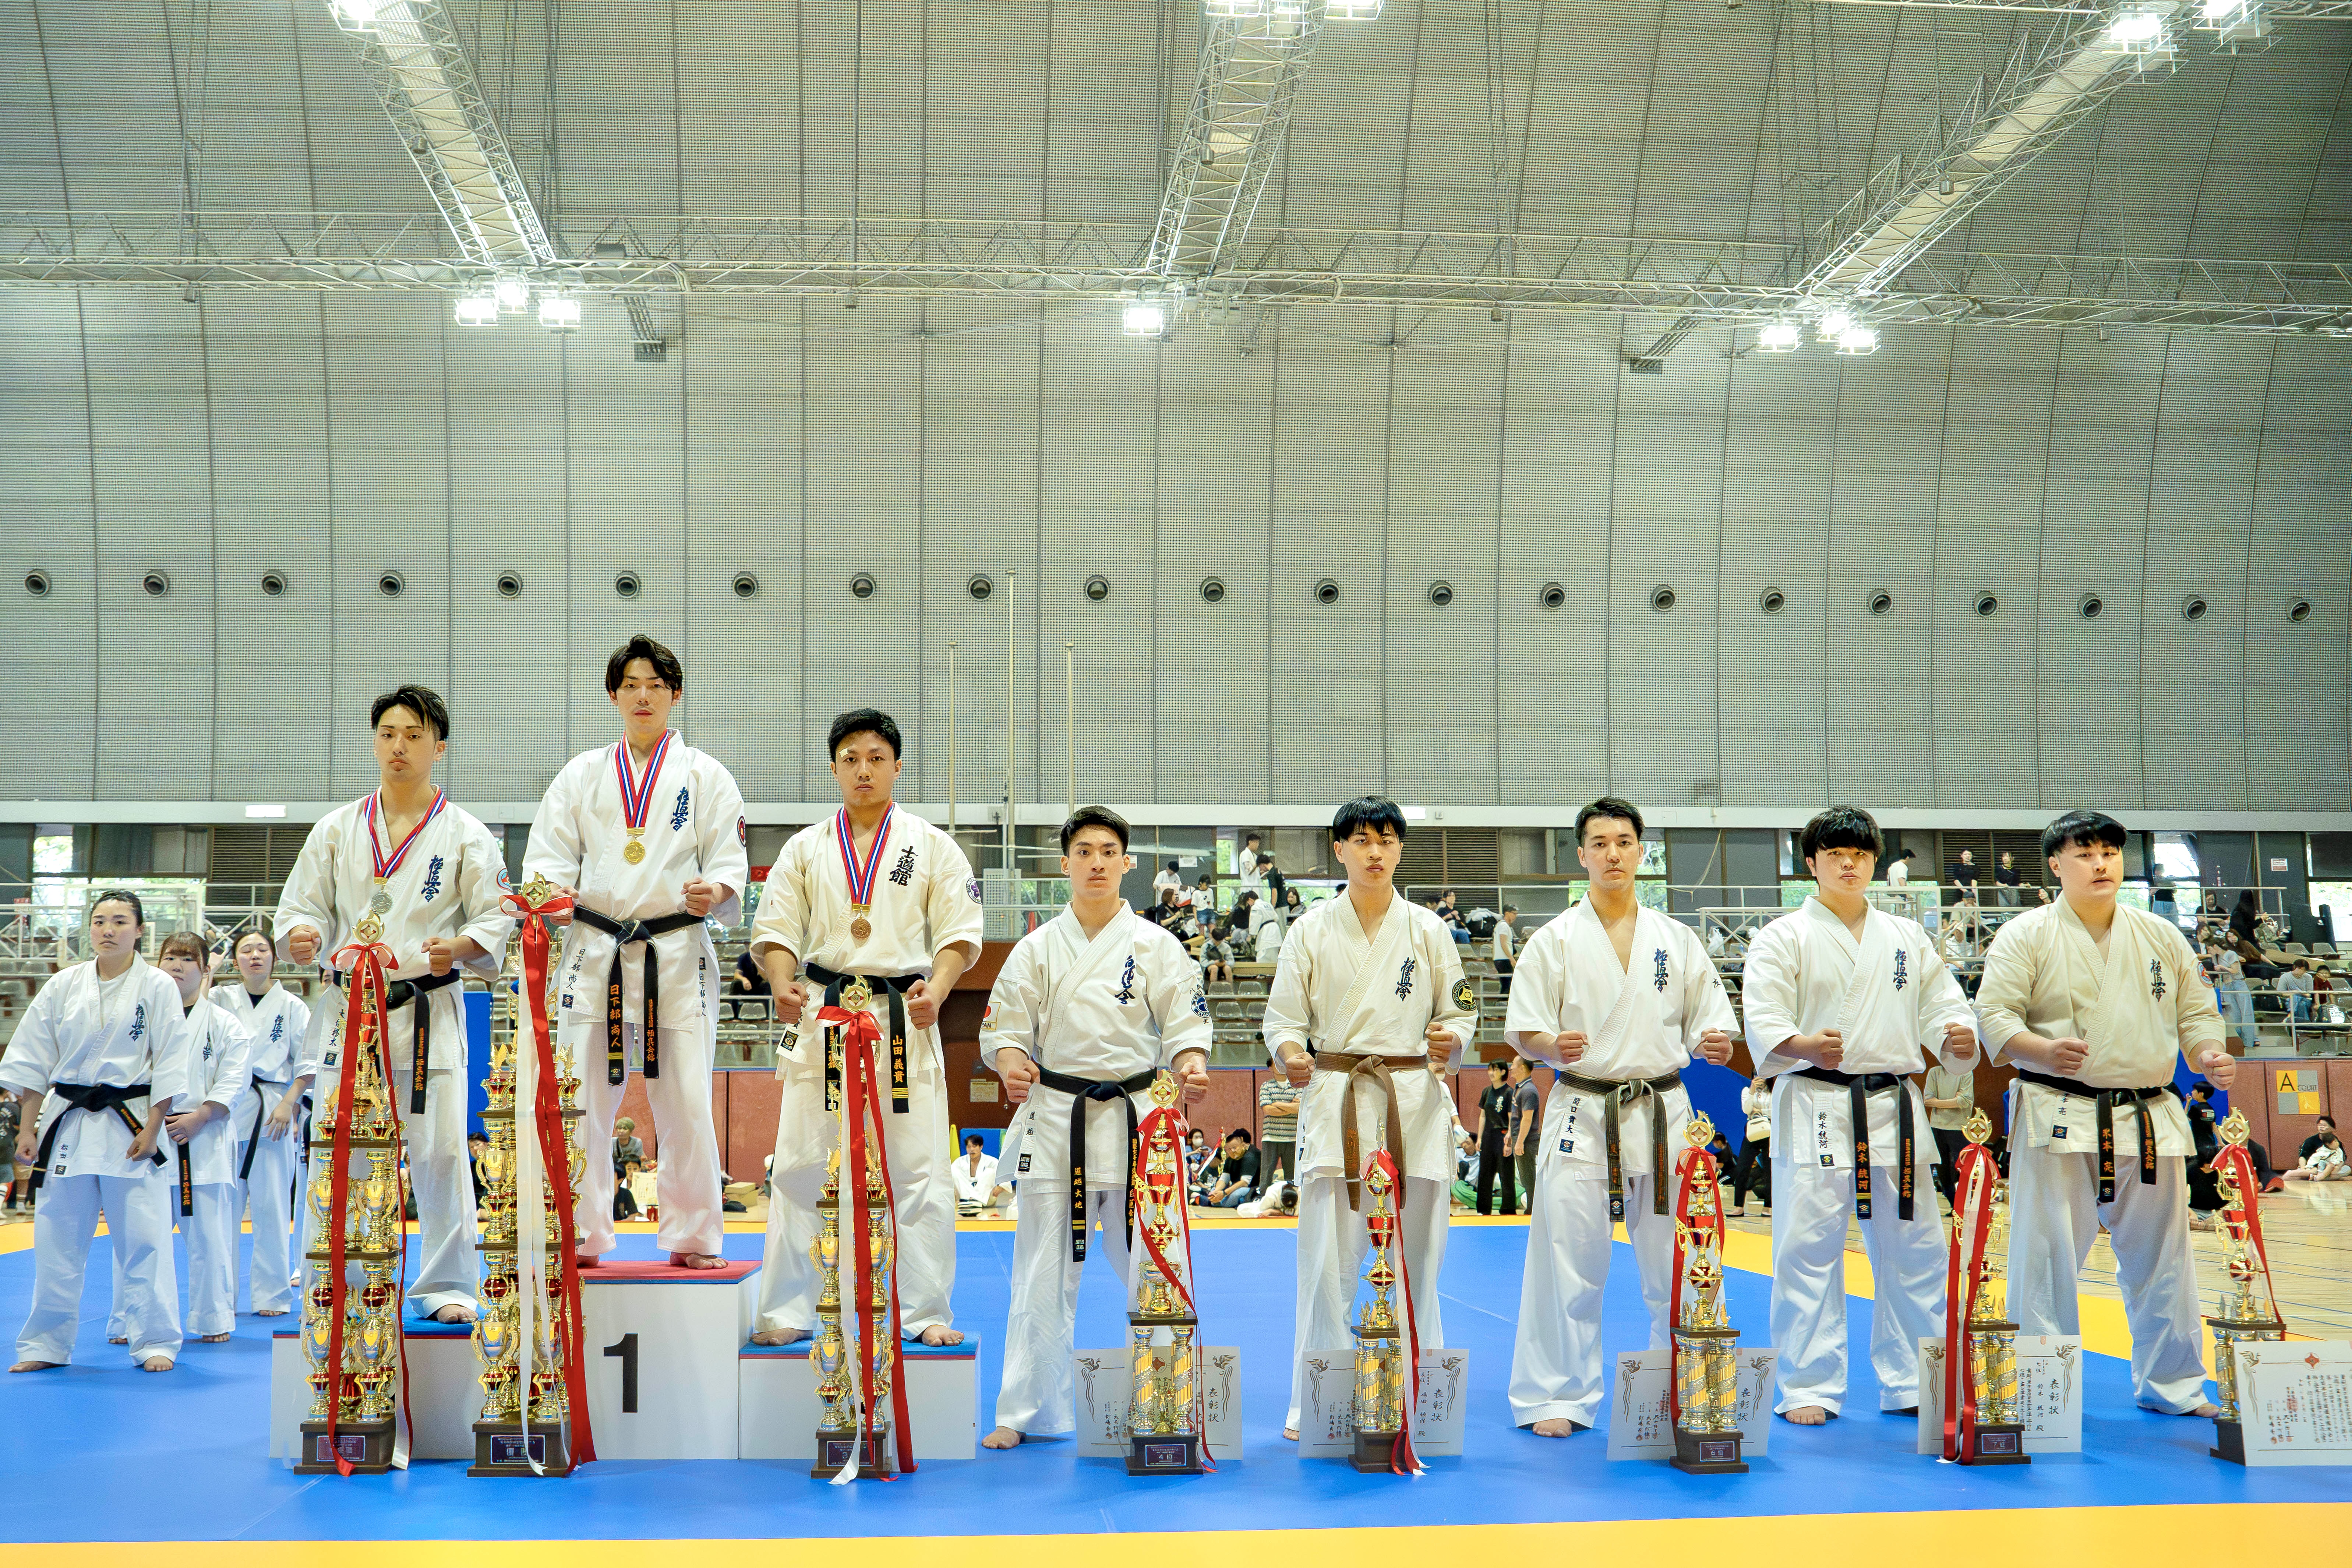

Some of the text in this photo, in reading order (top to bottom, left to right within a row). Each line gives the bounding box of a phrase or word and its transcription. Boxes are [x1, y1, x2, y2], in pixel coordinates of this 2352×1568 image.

[889, 845, 919, 886] 士道館
[566, 948, 586, 990] 日下部尚人
[610, 984, 621, 1048] 日下部尚人
[892, 1035, 905, 1083] 山田義貴
[2279, 1072, 2295, 1091] A
[1565, 1097, 1582, 1134] 関口貴大
[1818, 1112, 1828, 1149] 鈴木統河
[1073, 1167, 1083, 1209] 道越大地
[603, 1333, 638, 1413] 1
[1208, 1387, 1219, 1423] 表彰状
[1431, 1388, 1444, 1422] 表彰状
[1737, 1387, 1751, 1422] 表彰状
[2048, 1378, 2060, 1415] 表彰状
